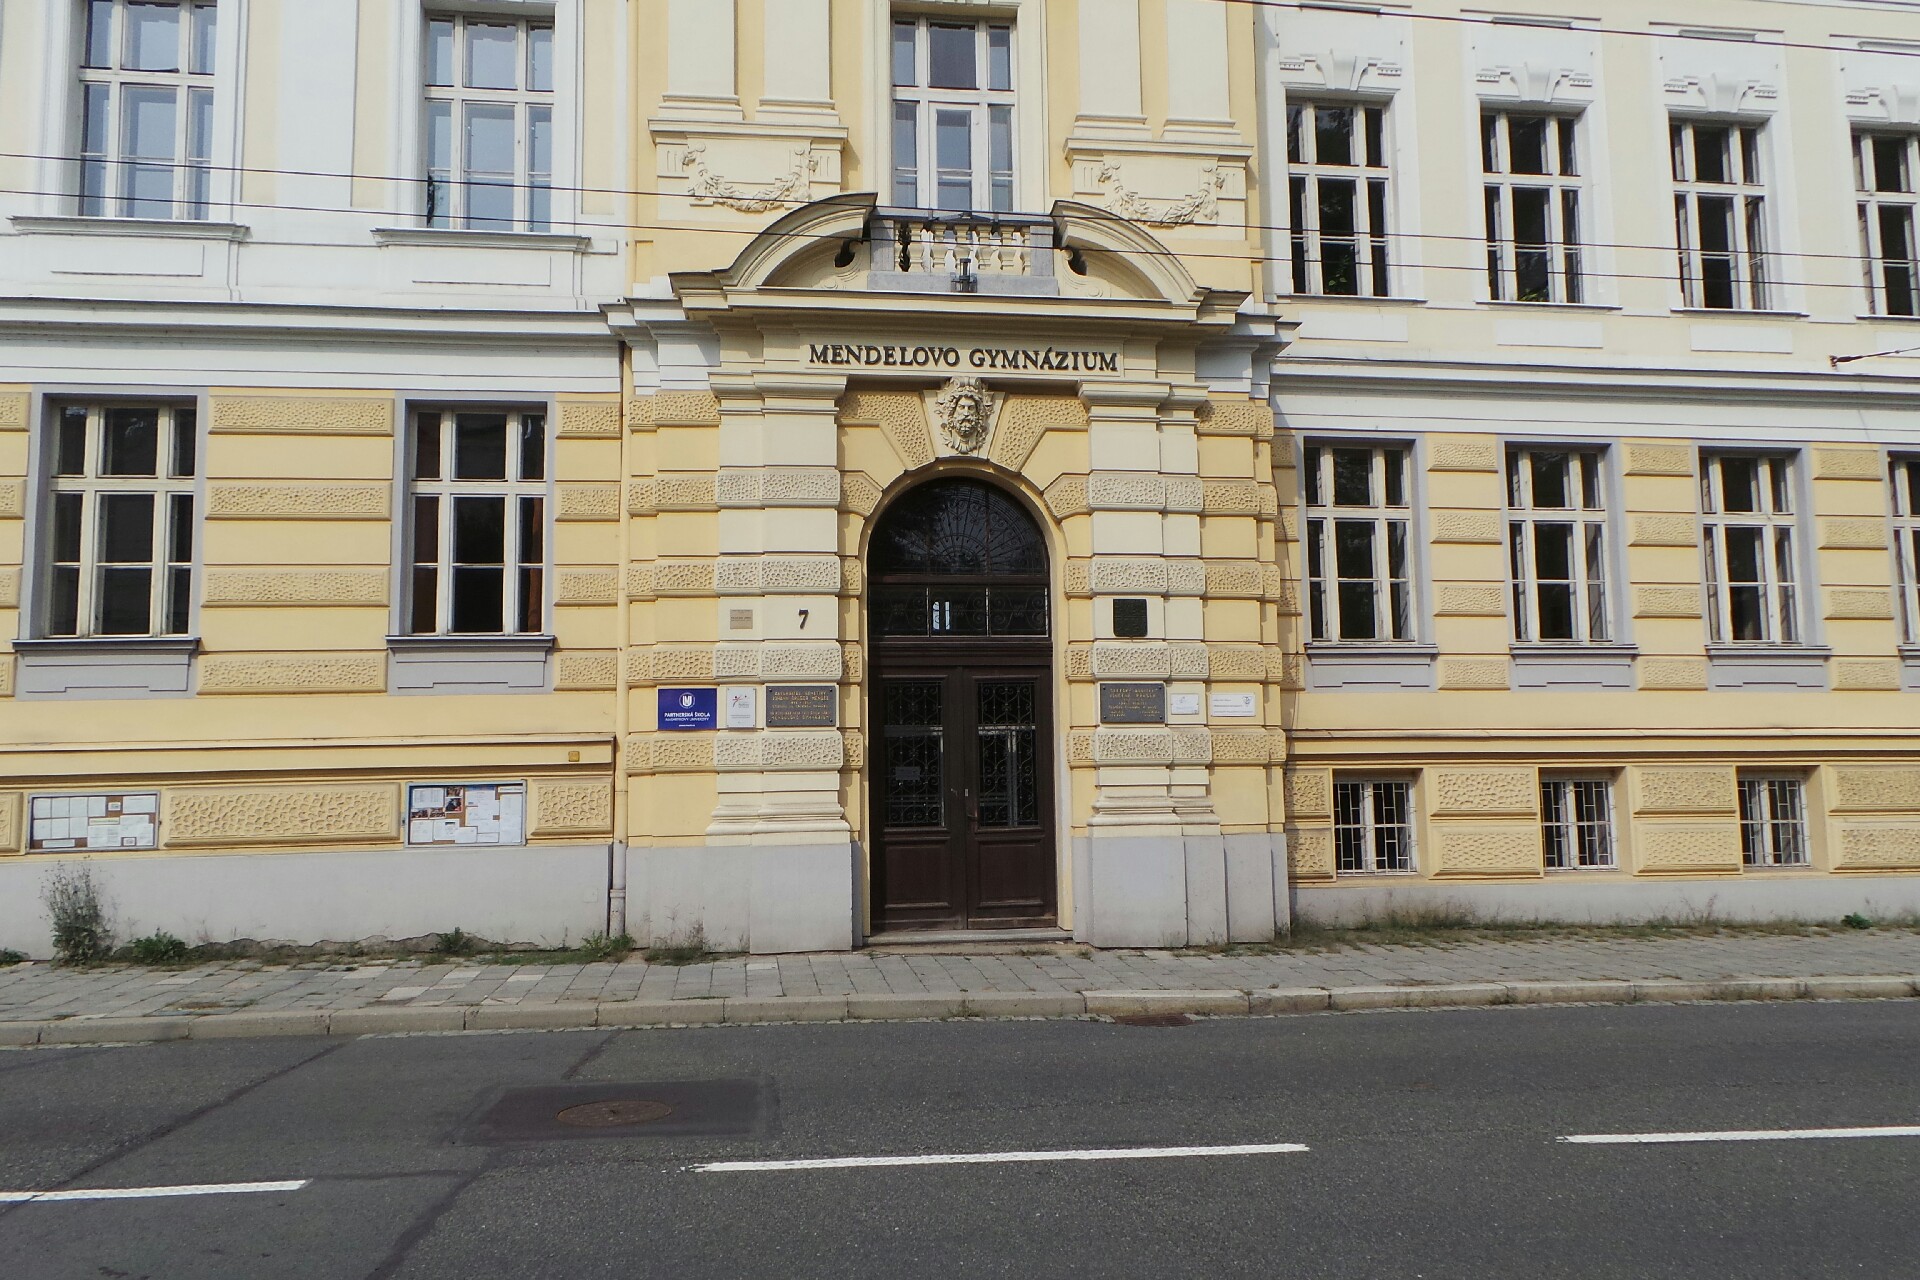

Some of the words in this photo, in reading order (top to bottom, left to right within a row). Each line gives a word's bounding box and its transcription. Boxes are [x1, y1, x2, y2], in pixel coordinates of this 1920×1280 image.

[809, 344, 961, 367] MENDELOVO
[968, 346, 1118, 372] GYMNÁZIUM
[798, 609, 809, 630] 7
